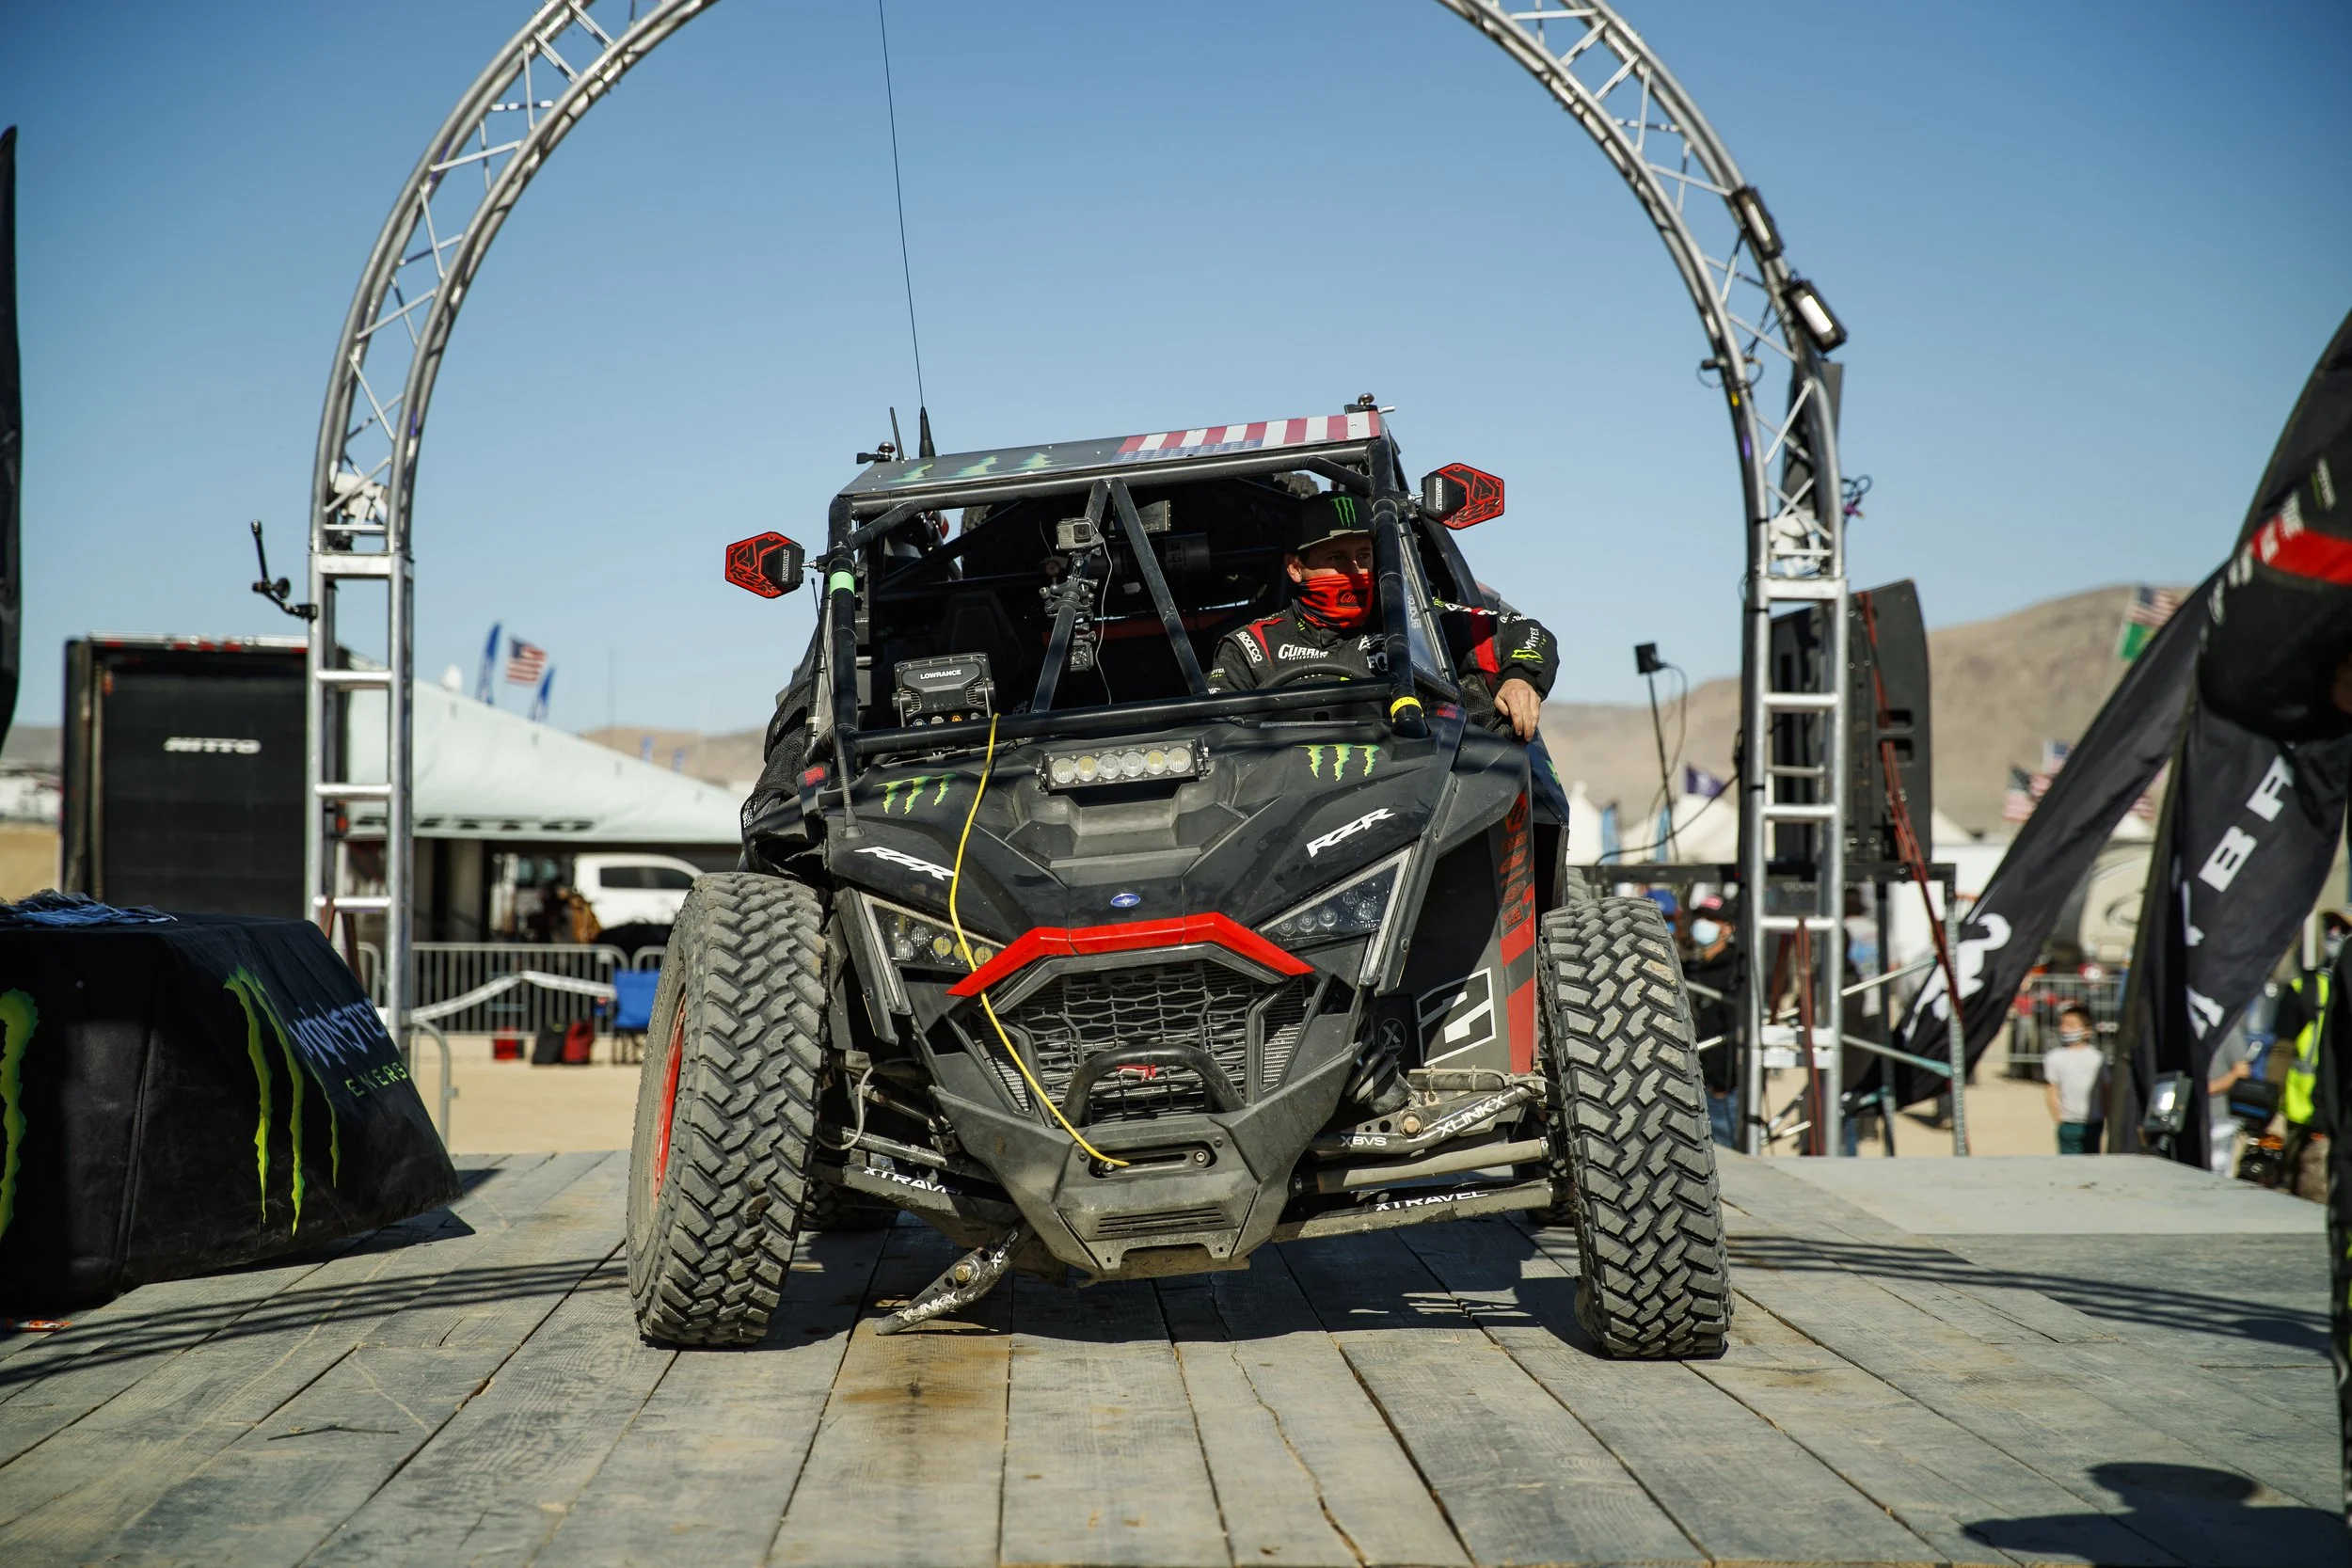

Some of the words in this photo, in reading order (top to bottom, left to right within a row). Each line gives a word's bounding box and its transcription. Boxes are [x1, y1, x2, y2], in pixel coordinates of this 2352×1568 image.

[1235, 631, 1263, 663] sparco
[919, 669, 961, 680] LOWRANCE
[1306, 808, 1396, 858] RZR
[853, 846, 956, 881] RZR
[287, 997, 388, 1069] MONSTE
[1437, 1094, 1507, 1137] XLINKX
[1340, 1135, 1388, 1147] XBVS
[1375, 1191, 1488, 1212] XTRAVEL
